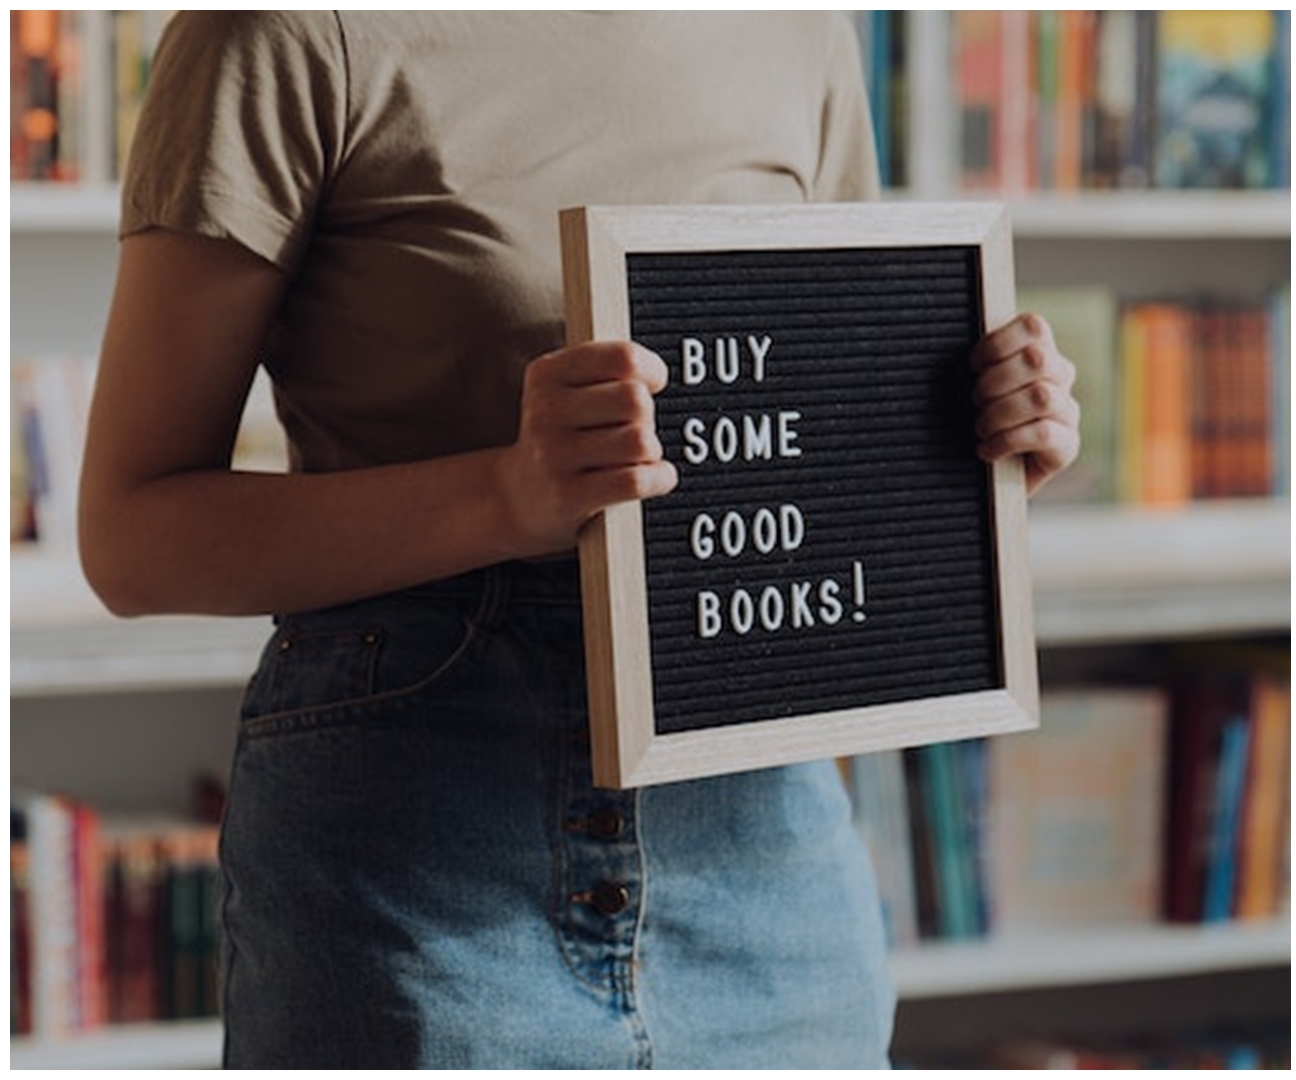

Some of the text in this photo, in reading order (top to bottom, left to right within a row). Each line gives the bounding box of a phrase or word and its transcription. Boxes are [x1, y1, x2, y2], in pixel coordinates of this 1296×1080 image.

[682, 335, 772, 385] BUY
[683, 411, 802, 464] SOME
[691, 504, 804, 560] GOOD
[697, 561, 866, 638] BOOKS!
